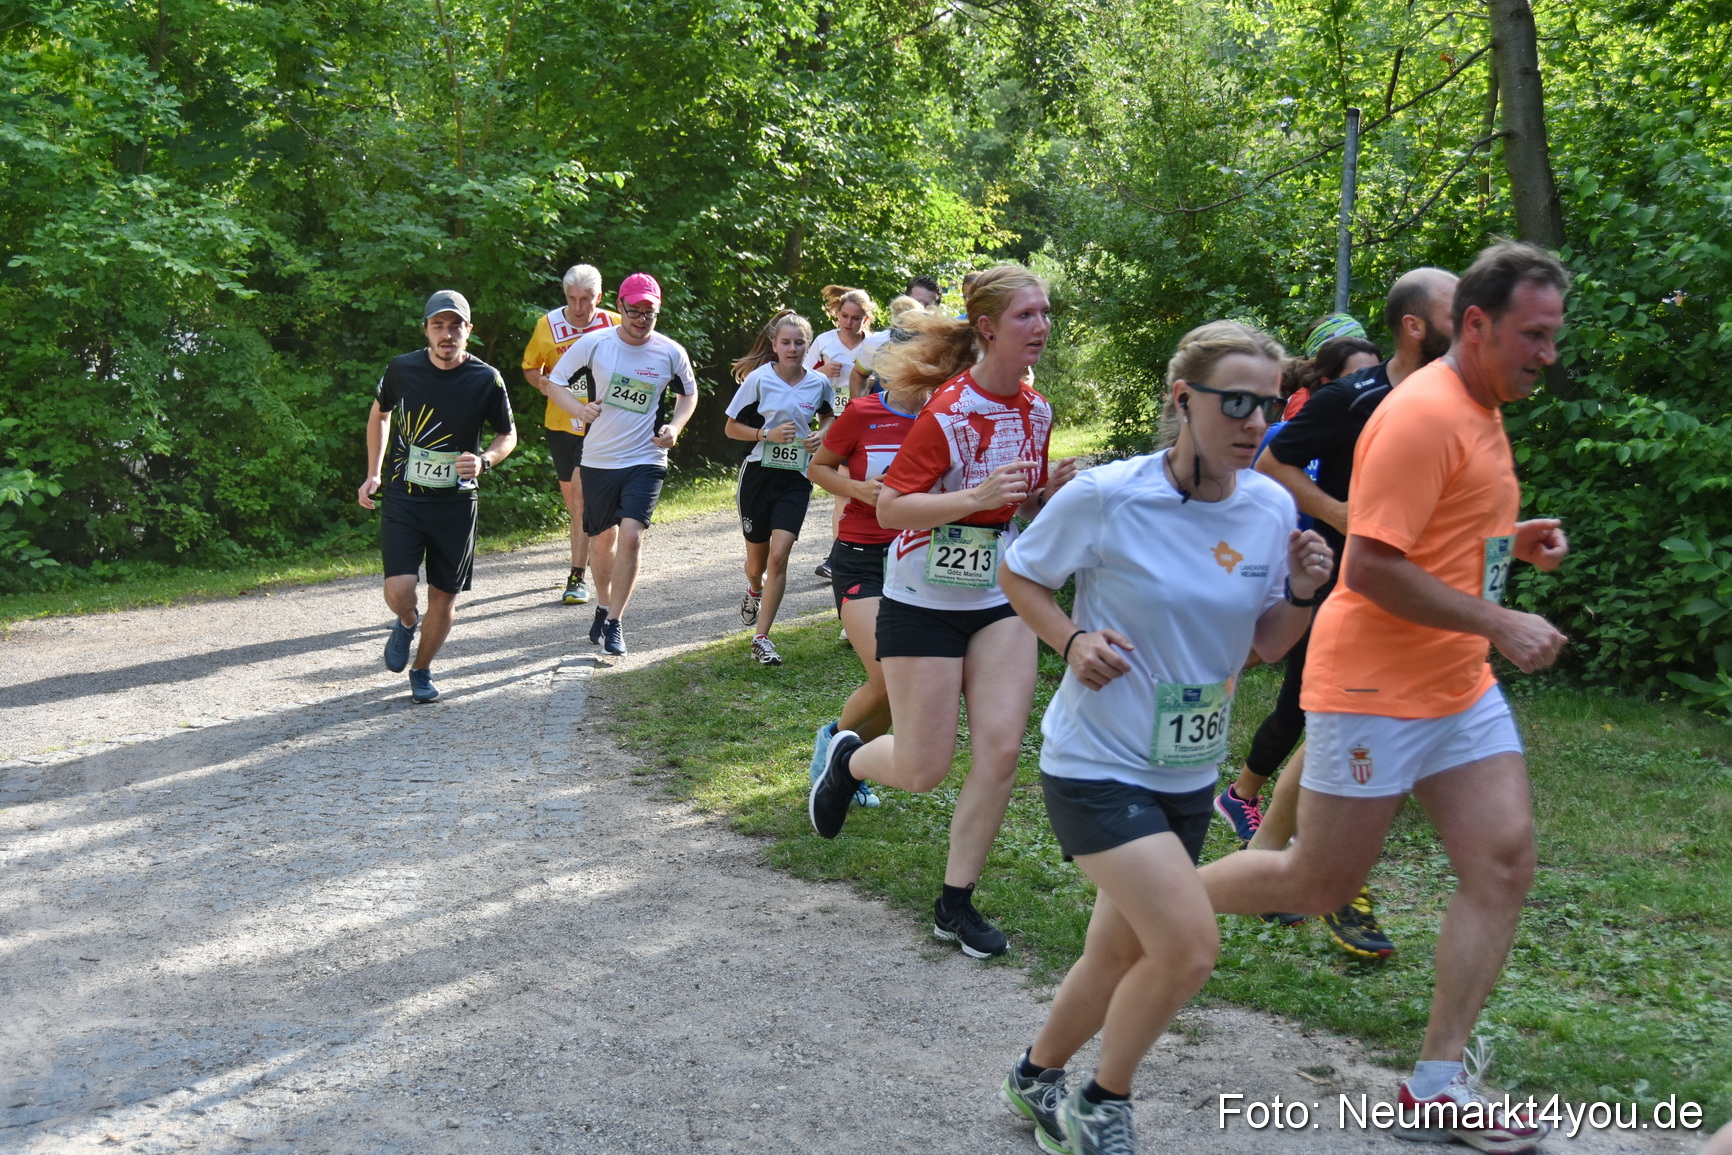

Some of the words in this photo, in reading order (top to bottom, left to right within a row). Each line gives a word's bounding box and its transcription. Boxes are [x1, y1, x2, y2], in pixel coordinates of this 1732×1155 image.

[611, 386, 647, 405] 2449
[834, 396, 851, 407] 36
[772, 446, 798, 461] 965
[415, 461, 451, 478] 1741
[935, 546, 992, 572] 2213
[947, 569, 962, 577] Götz
[1169, 706, 1228, 744] 1366
